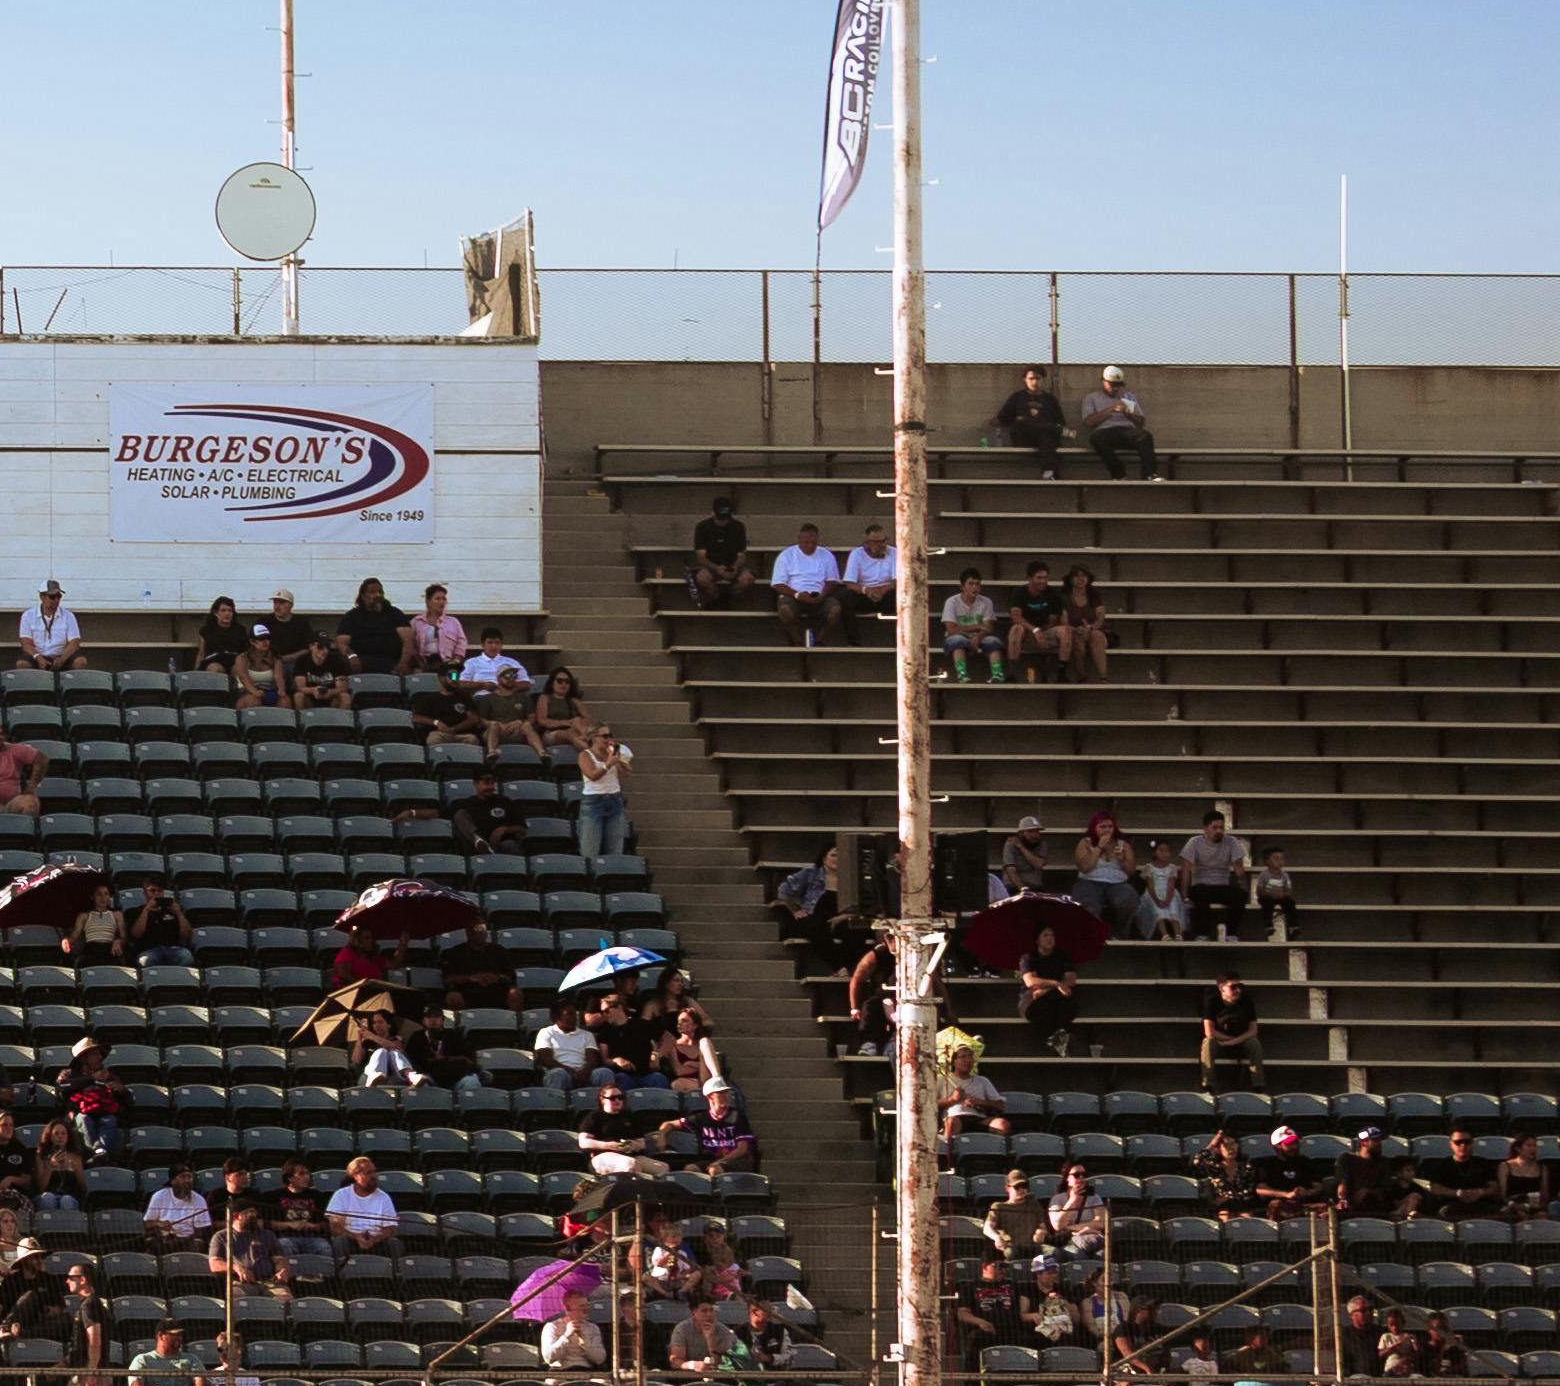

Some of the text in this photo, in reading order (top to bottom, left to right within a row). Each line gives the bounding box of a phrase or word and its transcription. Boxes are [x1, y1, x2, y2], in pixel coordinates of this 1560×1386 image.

[114, 435, 366, 464] BURGESON'S
[127, 468, 344, 483] HEATING A/C ELECTRICAL
[161, 486, 297, 500] SOLAR PLUMBING
[359, 510, 425, 522] Since 1949
